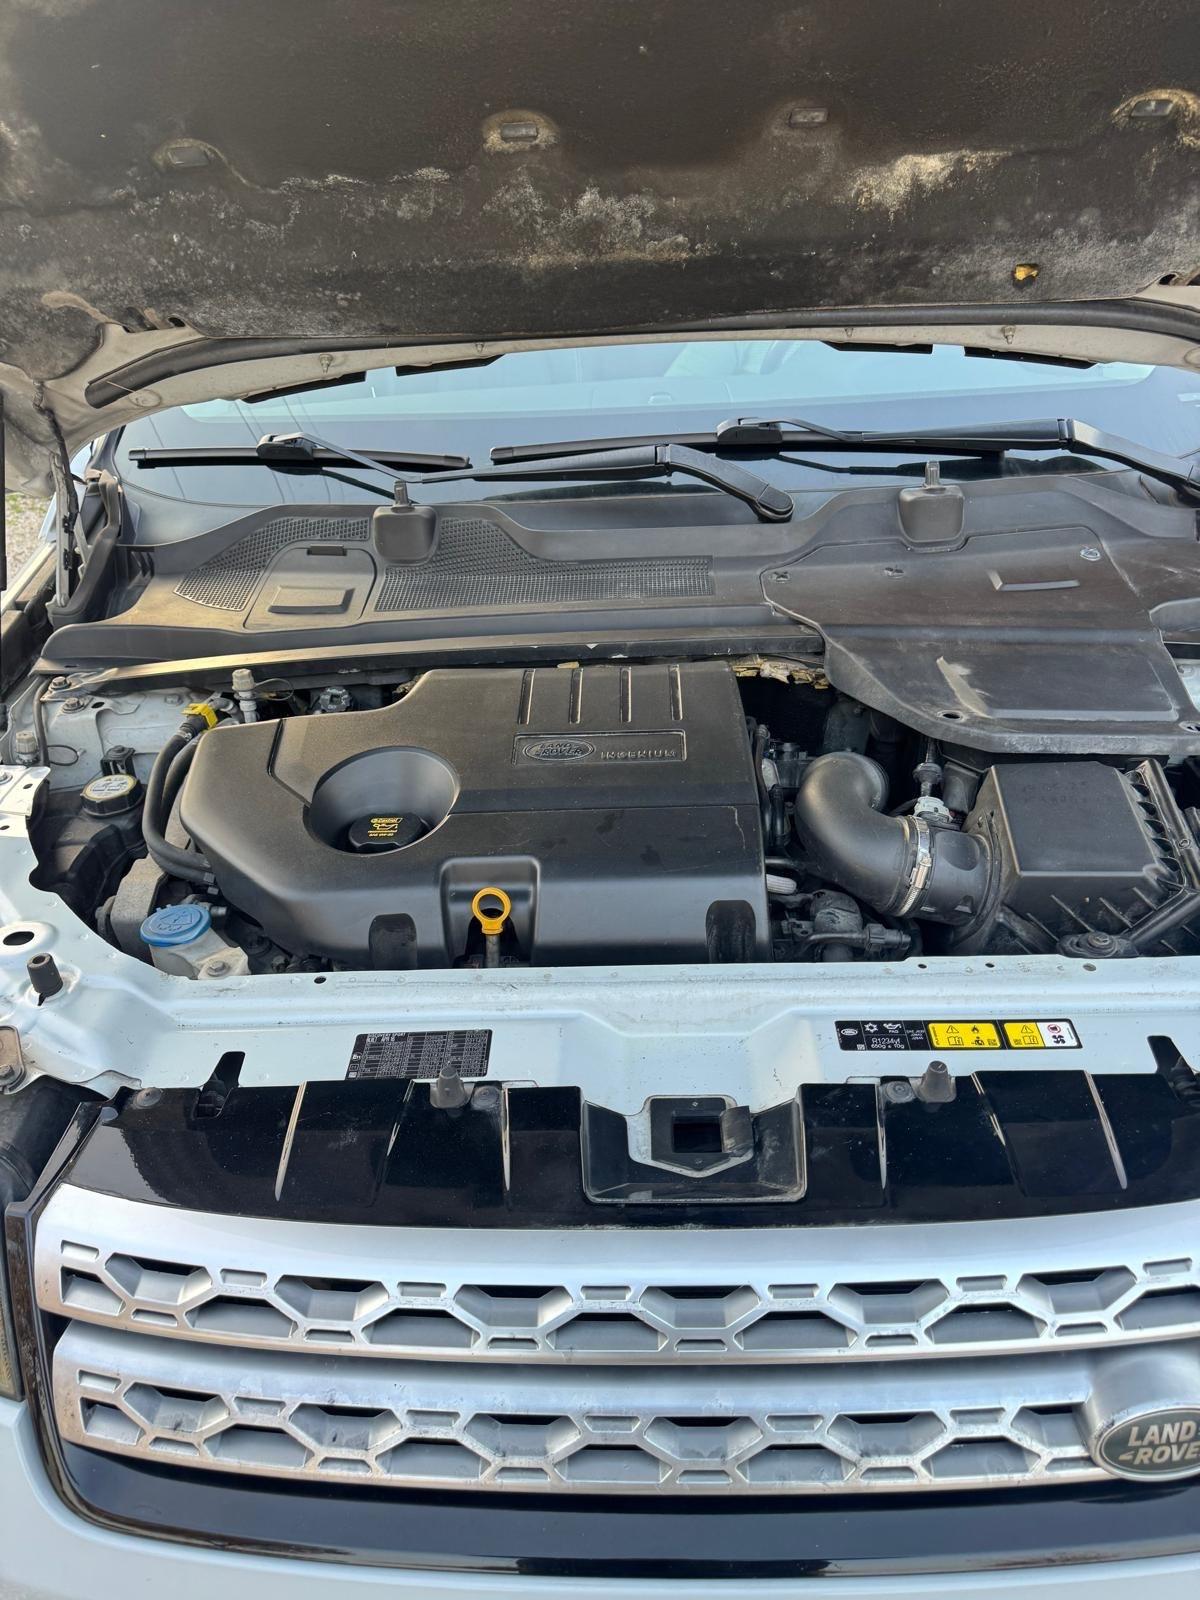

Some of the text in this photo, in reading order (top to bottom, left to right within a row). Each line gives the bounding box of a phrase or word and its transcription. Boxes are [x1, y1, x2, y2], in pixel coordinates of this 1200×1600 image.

[541, 747, 583, 755] ROVER
[1127, 1420, 1197, 1447] LAND
[1133, 1440, 1200, 1465] ROVE
